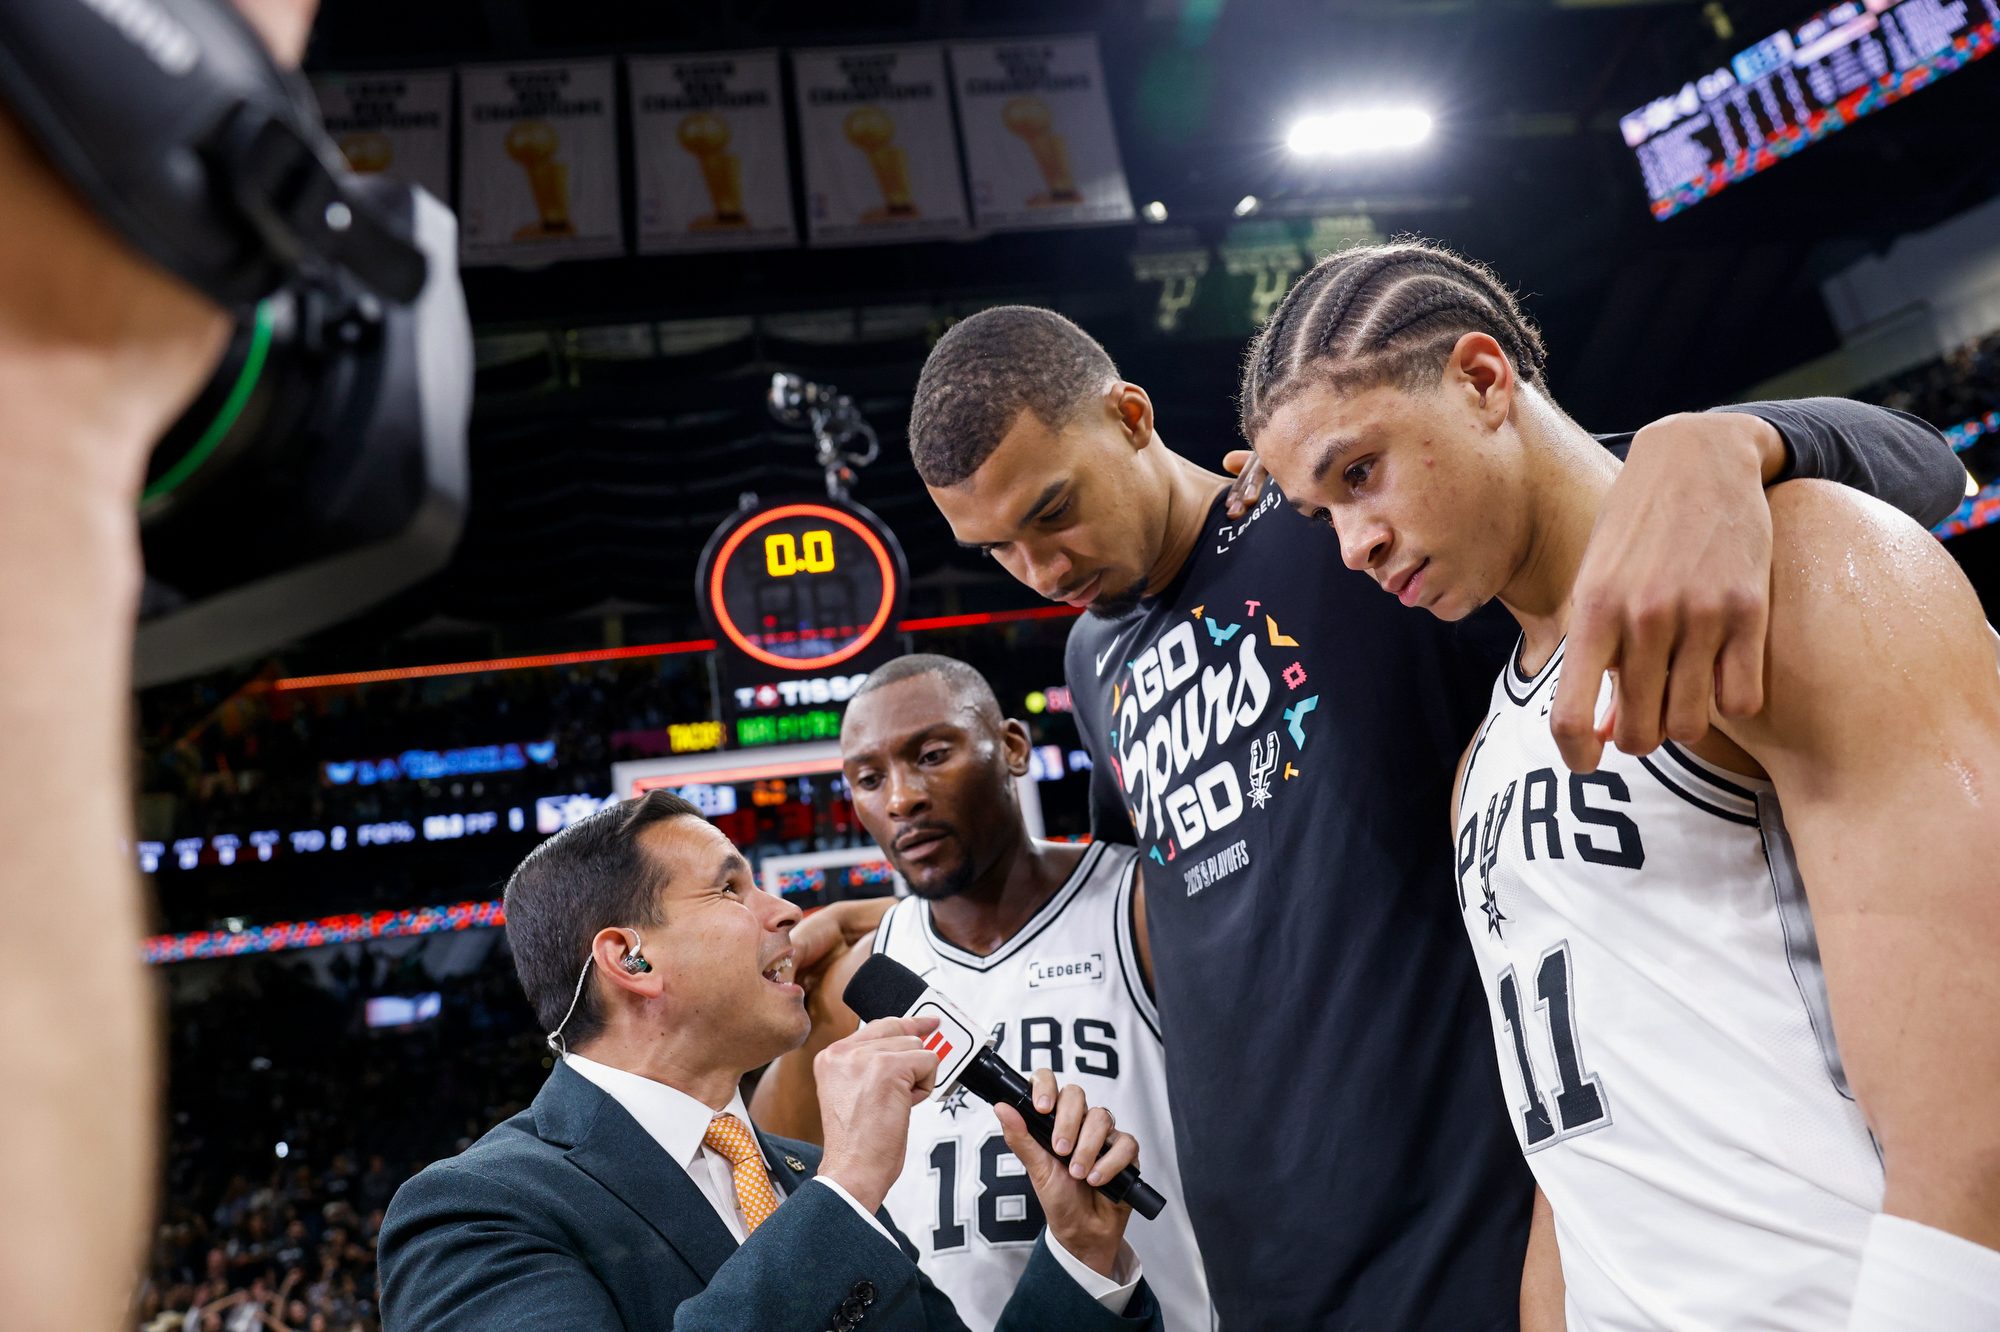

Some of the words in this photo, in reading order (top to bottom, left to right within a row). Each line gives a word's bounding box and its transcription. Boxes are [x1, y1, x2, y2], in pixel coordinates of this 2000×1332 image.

[765, 530, 835, 577] 0.0
[1132, 621, 1200, 714] GO
[1119, 633, 1272, 840] Spurs
[1165, 760, 1244, 850] GO
[1206, 839, 1250, 883] PLAYOFFS
[1038, 962, 1092, 979] LEDGER
[1498, 940, 1612, 1154] 11
[927, 1132, 1047, 1255] 18
